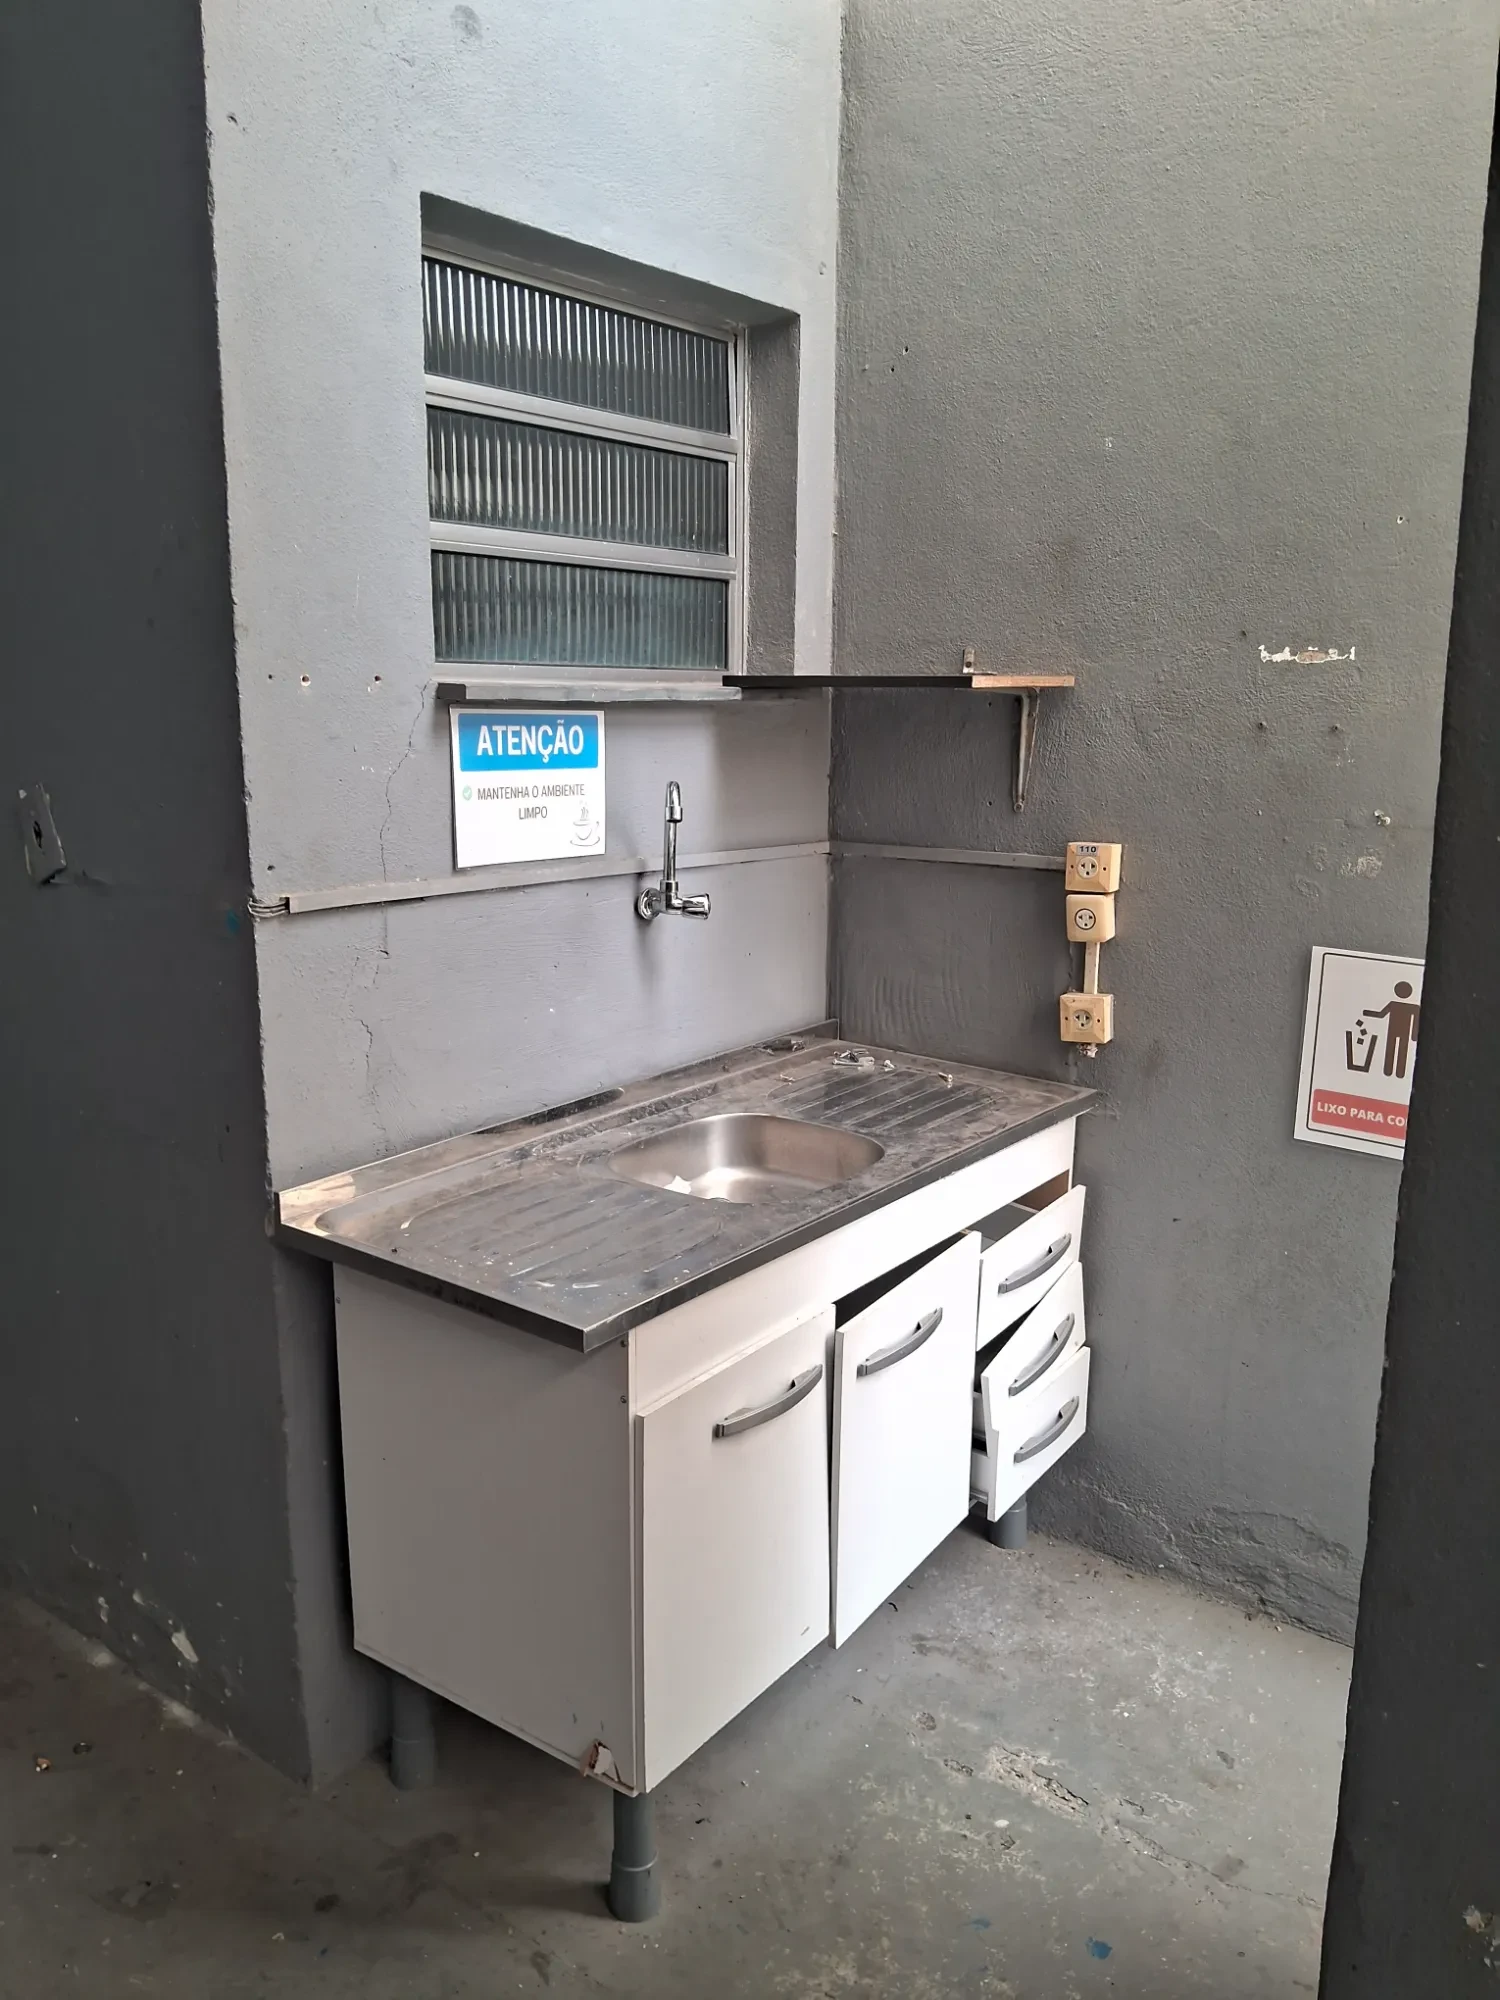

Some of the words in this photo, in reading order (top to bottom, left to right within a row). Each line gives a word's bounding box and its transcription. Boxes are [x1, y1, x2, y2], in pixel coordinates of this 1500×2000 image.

[477, 719, 584, 763] ATENÇÃO
[477, 786, 530, 801] MANTENHA
[531, 785, 539, 798] O
[541, 783, 585, 798] AMBIENTE
[518, 806, 548, 820] LIMPO
[1079, 845, 1097, 853] 110
[1316, 1101, 1347, 1116] LIXO
[1350, 1107, 1384, 1123] PARA
[1387, 1114, 1408, 1127] CO
